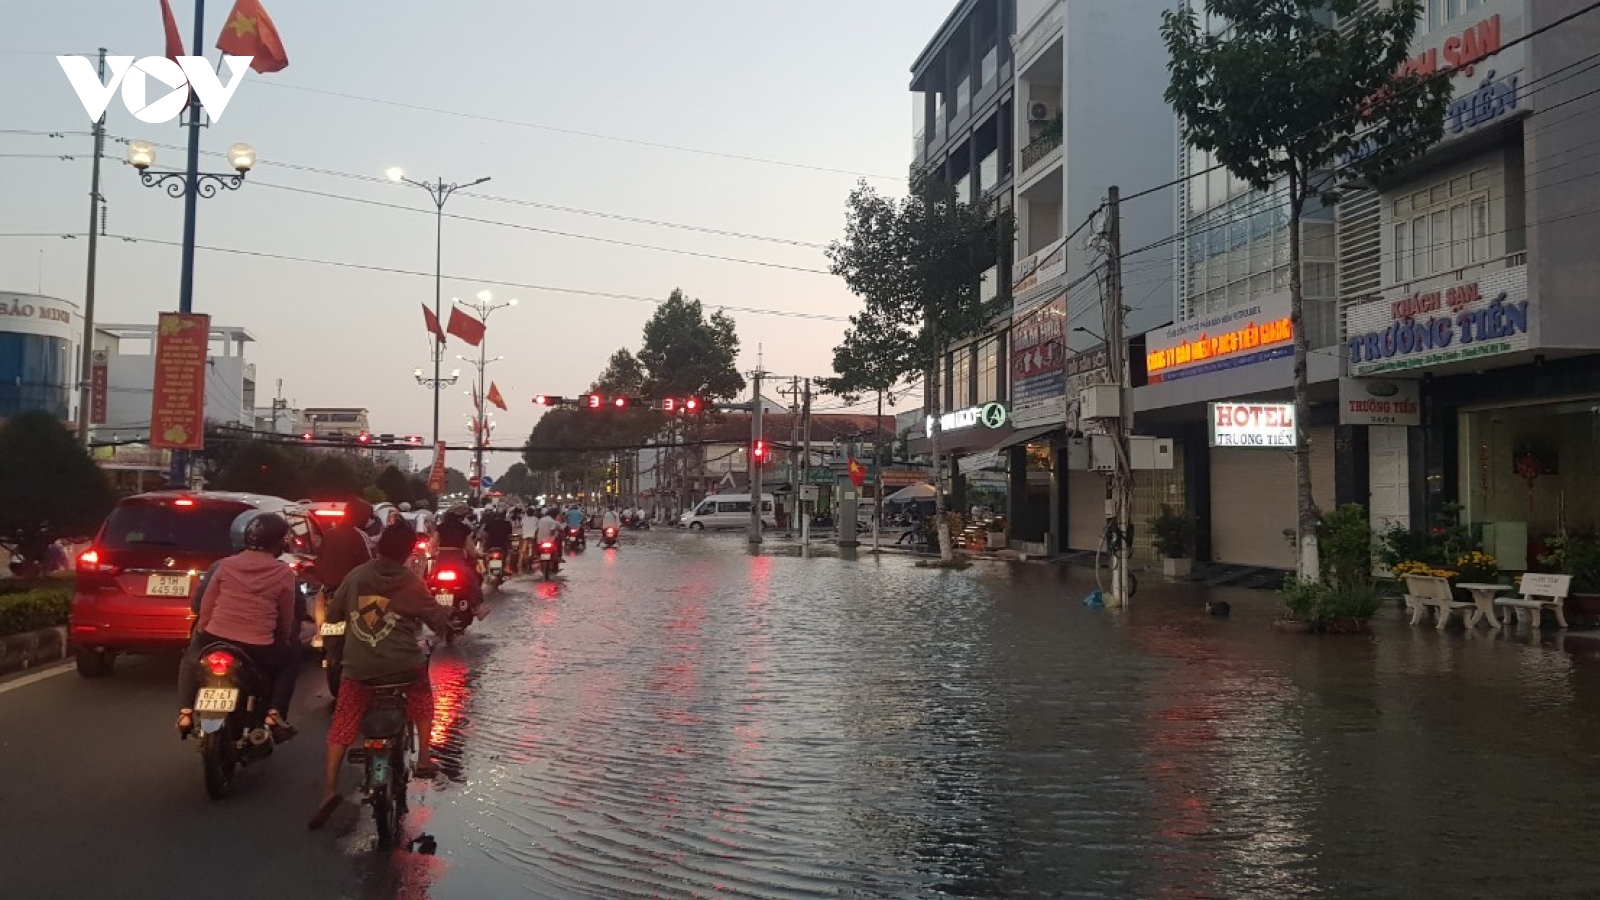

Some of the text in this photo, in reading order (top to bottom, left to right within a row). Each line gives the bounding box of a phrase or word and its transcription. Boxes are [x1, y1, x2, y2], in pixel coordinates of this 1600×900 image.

[1443, 14, 1500, 78] SẠN
[1449, 69, 1518, 134] TIẾN
[1391, 290, 1441, 319] KHÁCH
[1349, 291, 1528, 363] TRƯỜNG TIẾN
[590, 395, 599, 407] 3
[664, 398, 673, 410] 3
[1216, 406, 1292, 427] HOTEL
